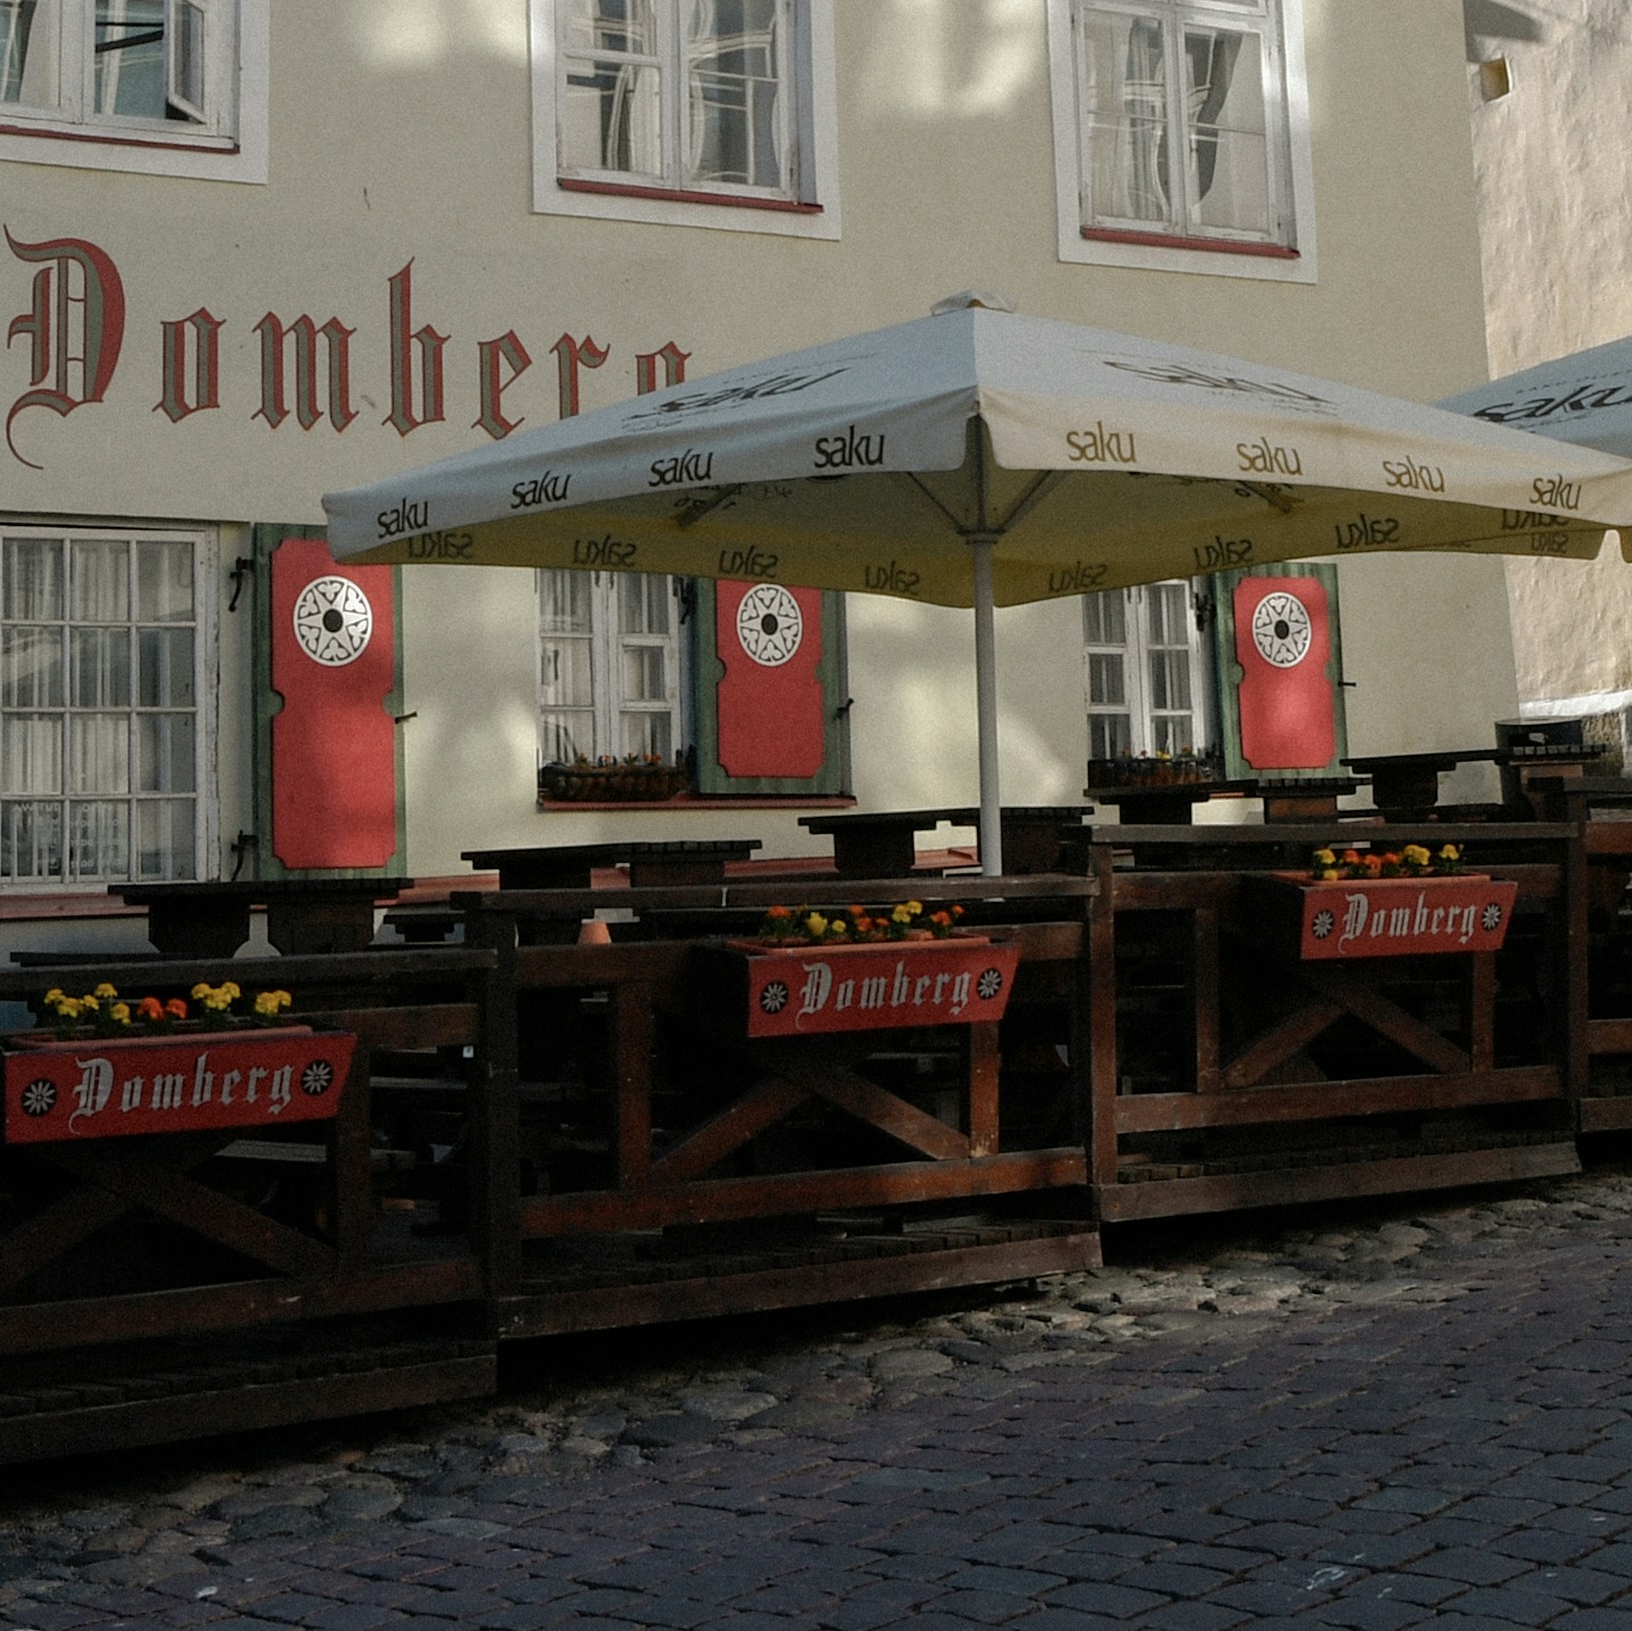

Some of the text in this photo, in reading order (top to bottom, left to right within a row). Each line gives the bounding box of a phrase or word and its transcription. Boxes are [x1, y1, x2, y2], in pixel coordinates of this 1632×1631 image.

[814, 424, 885, 469] saku
[1066, 420, 1137, 464] saku
[1236, 436, 1303, 476] saku
[648, 448, 714, 487] saku
[1383, 455, 1446, 493] saku
[509, 469, 571, 509] saku
[1529, 473, 1582, 511] saku
[376, 497, 428, 539] saku
[1338, 891, 1477, 955] Domberg
[795, 959, 972, 1030] Domberg
[69, 1050, 294, 1135] Domberg
